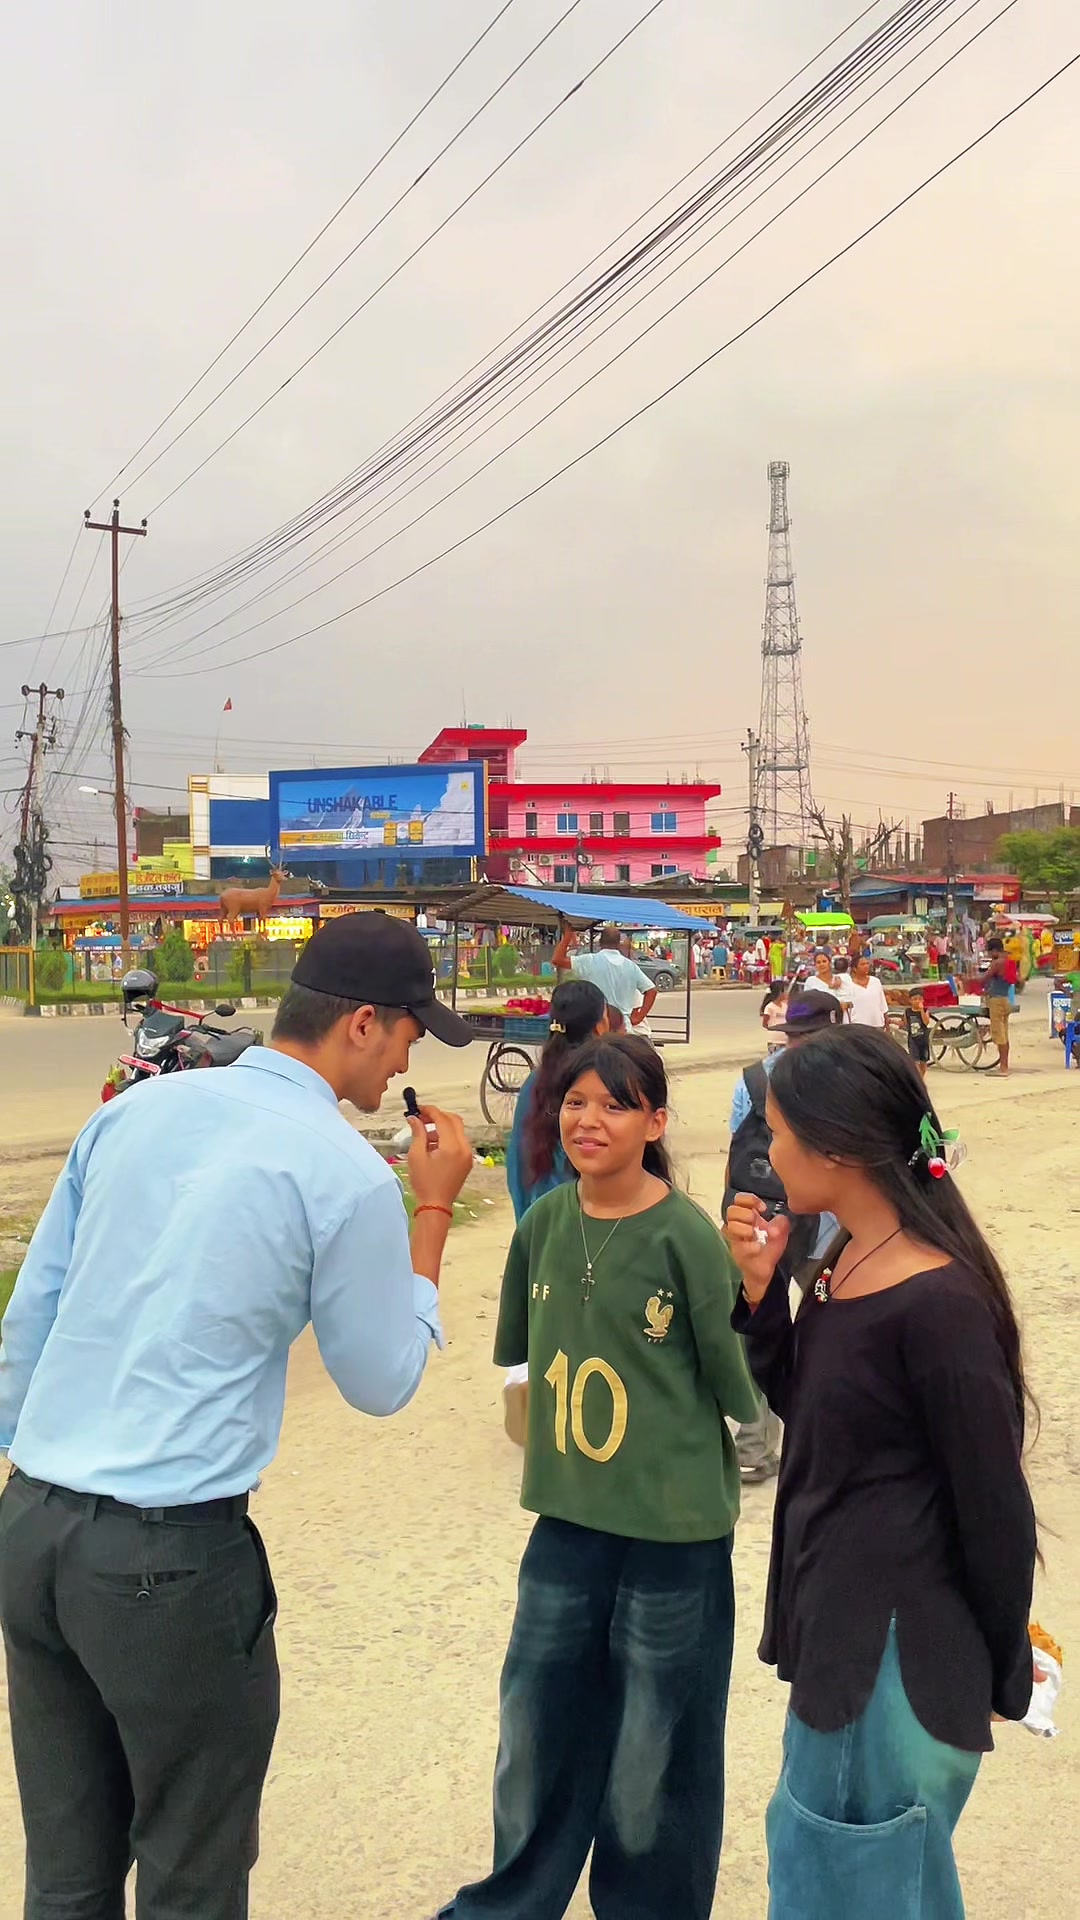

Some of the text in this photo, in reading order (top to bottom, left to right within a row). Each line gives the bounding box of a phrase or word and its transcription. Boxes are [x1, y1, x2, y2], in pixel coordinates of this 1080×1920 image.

[308, 794, 398, 813] UNSHAKABLE
[693, 904, 722, 914] पसल
[544, 1349, 628, 1463] 10
